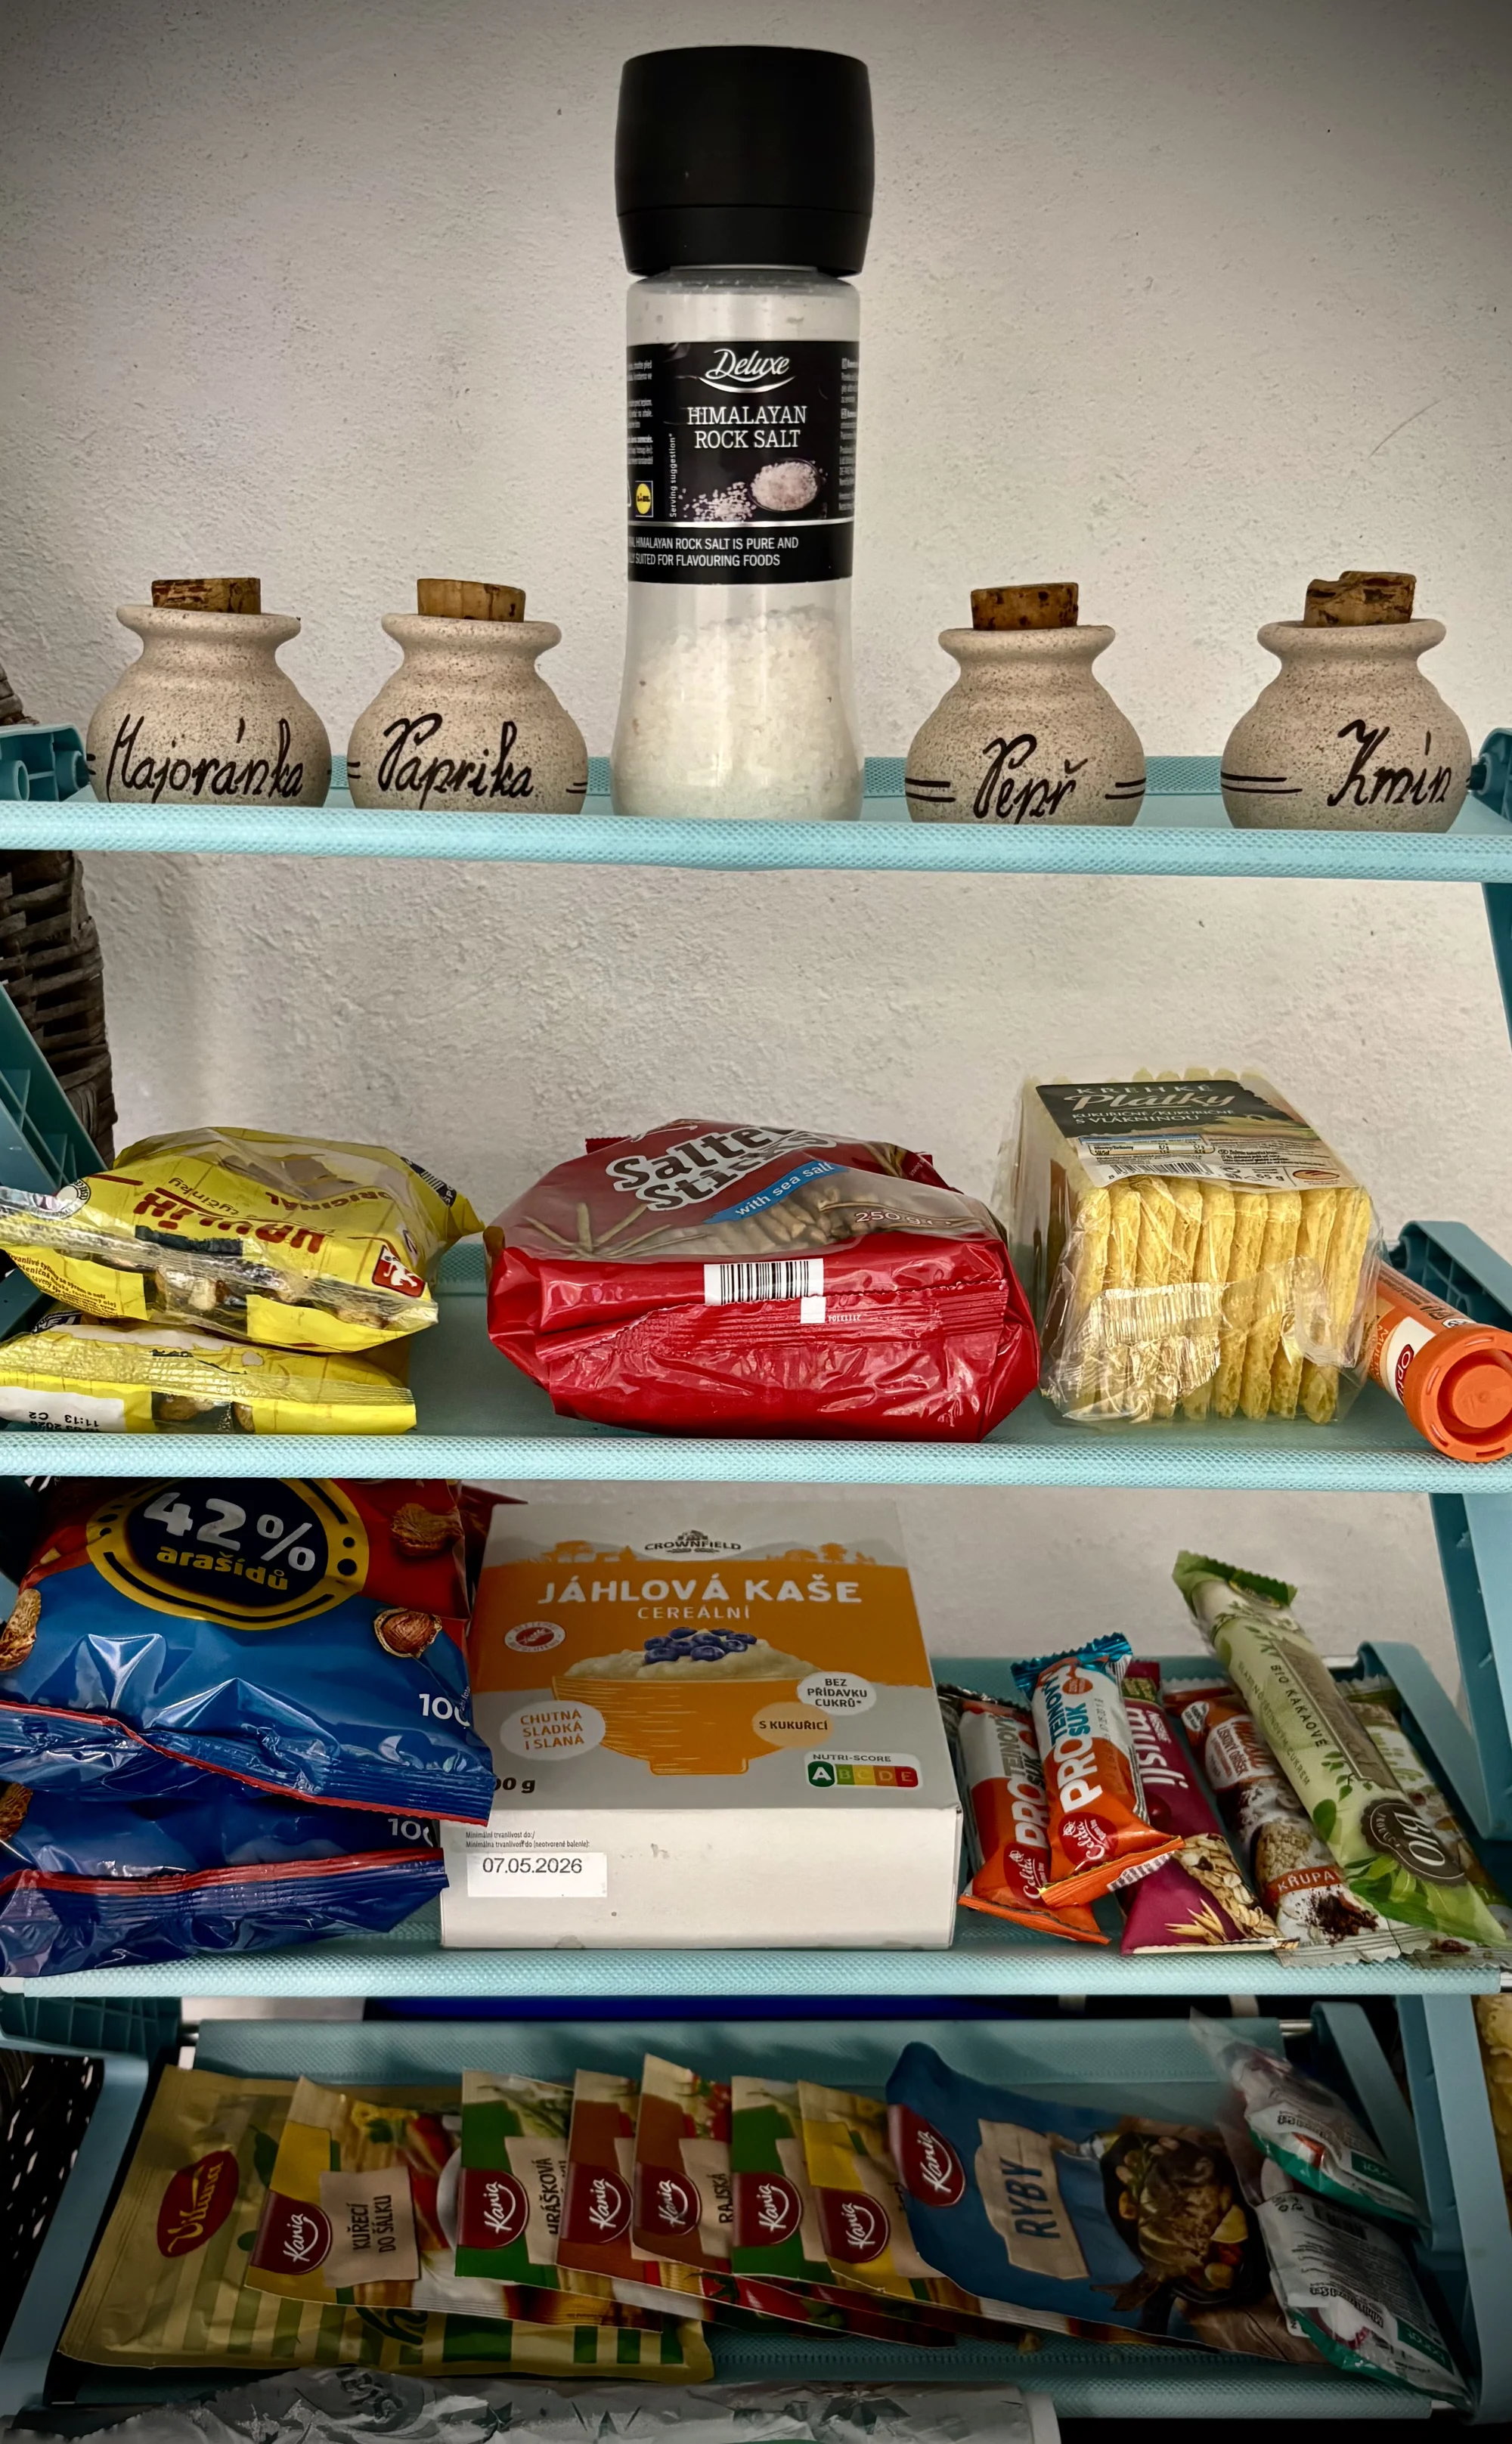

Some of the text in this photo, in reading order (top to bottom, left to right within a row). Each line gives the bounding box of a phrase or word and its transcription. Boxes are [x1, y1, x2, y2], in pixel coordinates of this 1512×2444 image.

[705, 349, 790, 382] Deluxe
[687, 406, 807, 425] HIMALAYAN
[695, 429, 801, 448] ROCK SALT
[669, 480, 678, 518] Serving
[636, 537, 673, 550] HIMALAYAN
[676, 538, 702, 550] ROCK
[705, 538, 730, 550] SALT
[733, 538, 742, 549] IS
[747, 538, 774, 549] PURE
[777, 537, 798, 548] AND
[636, 554, 655, 565] SUITED
[658, 554, 674, 565] FOR
[676, 554, 740, 565] FLAVOURING
[743, 554, 780, 565] FOODS
[378, 712, 534, 810] Paprika
[1327, 719, 1452, 807] Kmín
[973, 733, 1088, 824] Pepř
[1092, 1115, 1199, 1123] VLÁKNINOU
[735, 1160, 835, 1216] with sea salt
[854, 1211, 900, 1223] 250
[29, 1412, 100, 1427] 11:13 C2
[644, 1541, 741, 1552] CROWNFIELD
[156, 1547, 288, 1591] arašídů
[538, 1573, 862, 1604] JÁHLOVÁ KAŠE
[637, 1605, 750, 1620] CEREÁLNÍ
[825, 1678, 847, 1687] BEZ
[1271, 1665, 1288, 1684] BIO
[807, 1687, 867, 1698] PŘÍDAVKU
[520, 1708, 582, 1725] CHUTNÁ
[522, 1721, 583, 1737] SLADKÁ
[759, 1720, 828, 1730] S KUKUŘICÍ
[1065, 1702, 1090, 1736] SUK
[525, 1733, 584, 1751] I SLANÁ
[813, 1754, 891, 1762] NUTRI-SCORE
[812, 1767, 832, 1780] A
[838, 1769, 851, 1779] B
[879, 1770, 893, 1781] D
[900, 1771, 913, 1782] E
[1287, 1746, 1311, 1786] CUKREM
[522, 1780, 535, 1793] g
[1392, 1810, 1446, 1867] BIO
[482, 1857, 582, 1873] 07.05.2026
[1278, 1869, 1340, 1891] KŘUPA
[916, 2129, 953, 2195] Kania
[167, 2161, 224, 2253] Vitana
[483, 2180, 516, 2235] Kania
[589, 2177, 621, 2231] Kania
[657, 2179, 689, 2228] Kania
[707, 2173, 733, 2224] RAJSKÁ
[756, 2182, 790, 2233] Kania
[999, 2157, 1061, 2239] RYBY
[283, 2213, 319, 2263] Kania
[346, 2203, 370, 2251] KUŘECÍ
[373, 2195, 396, 2253] DO ŠÁLKU
[841, 2201, 876, 2250] Kania
